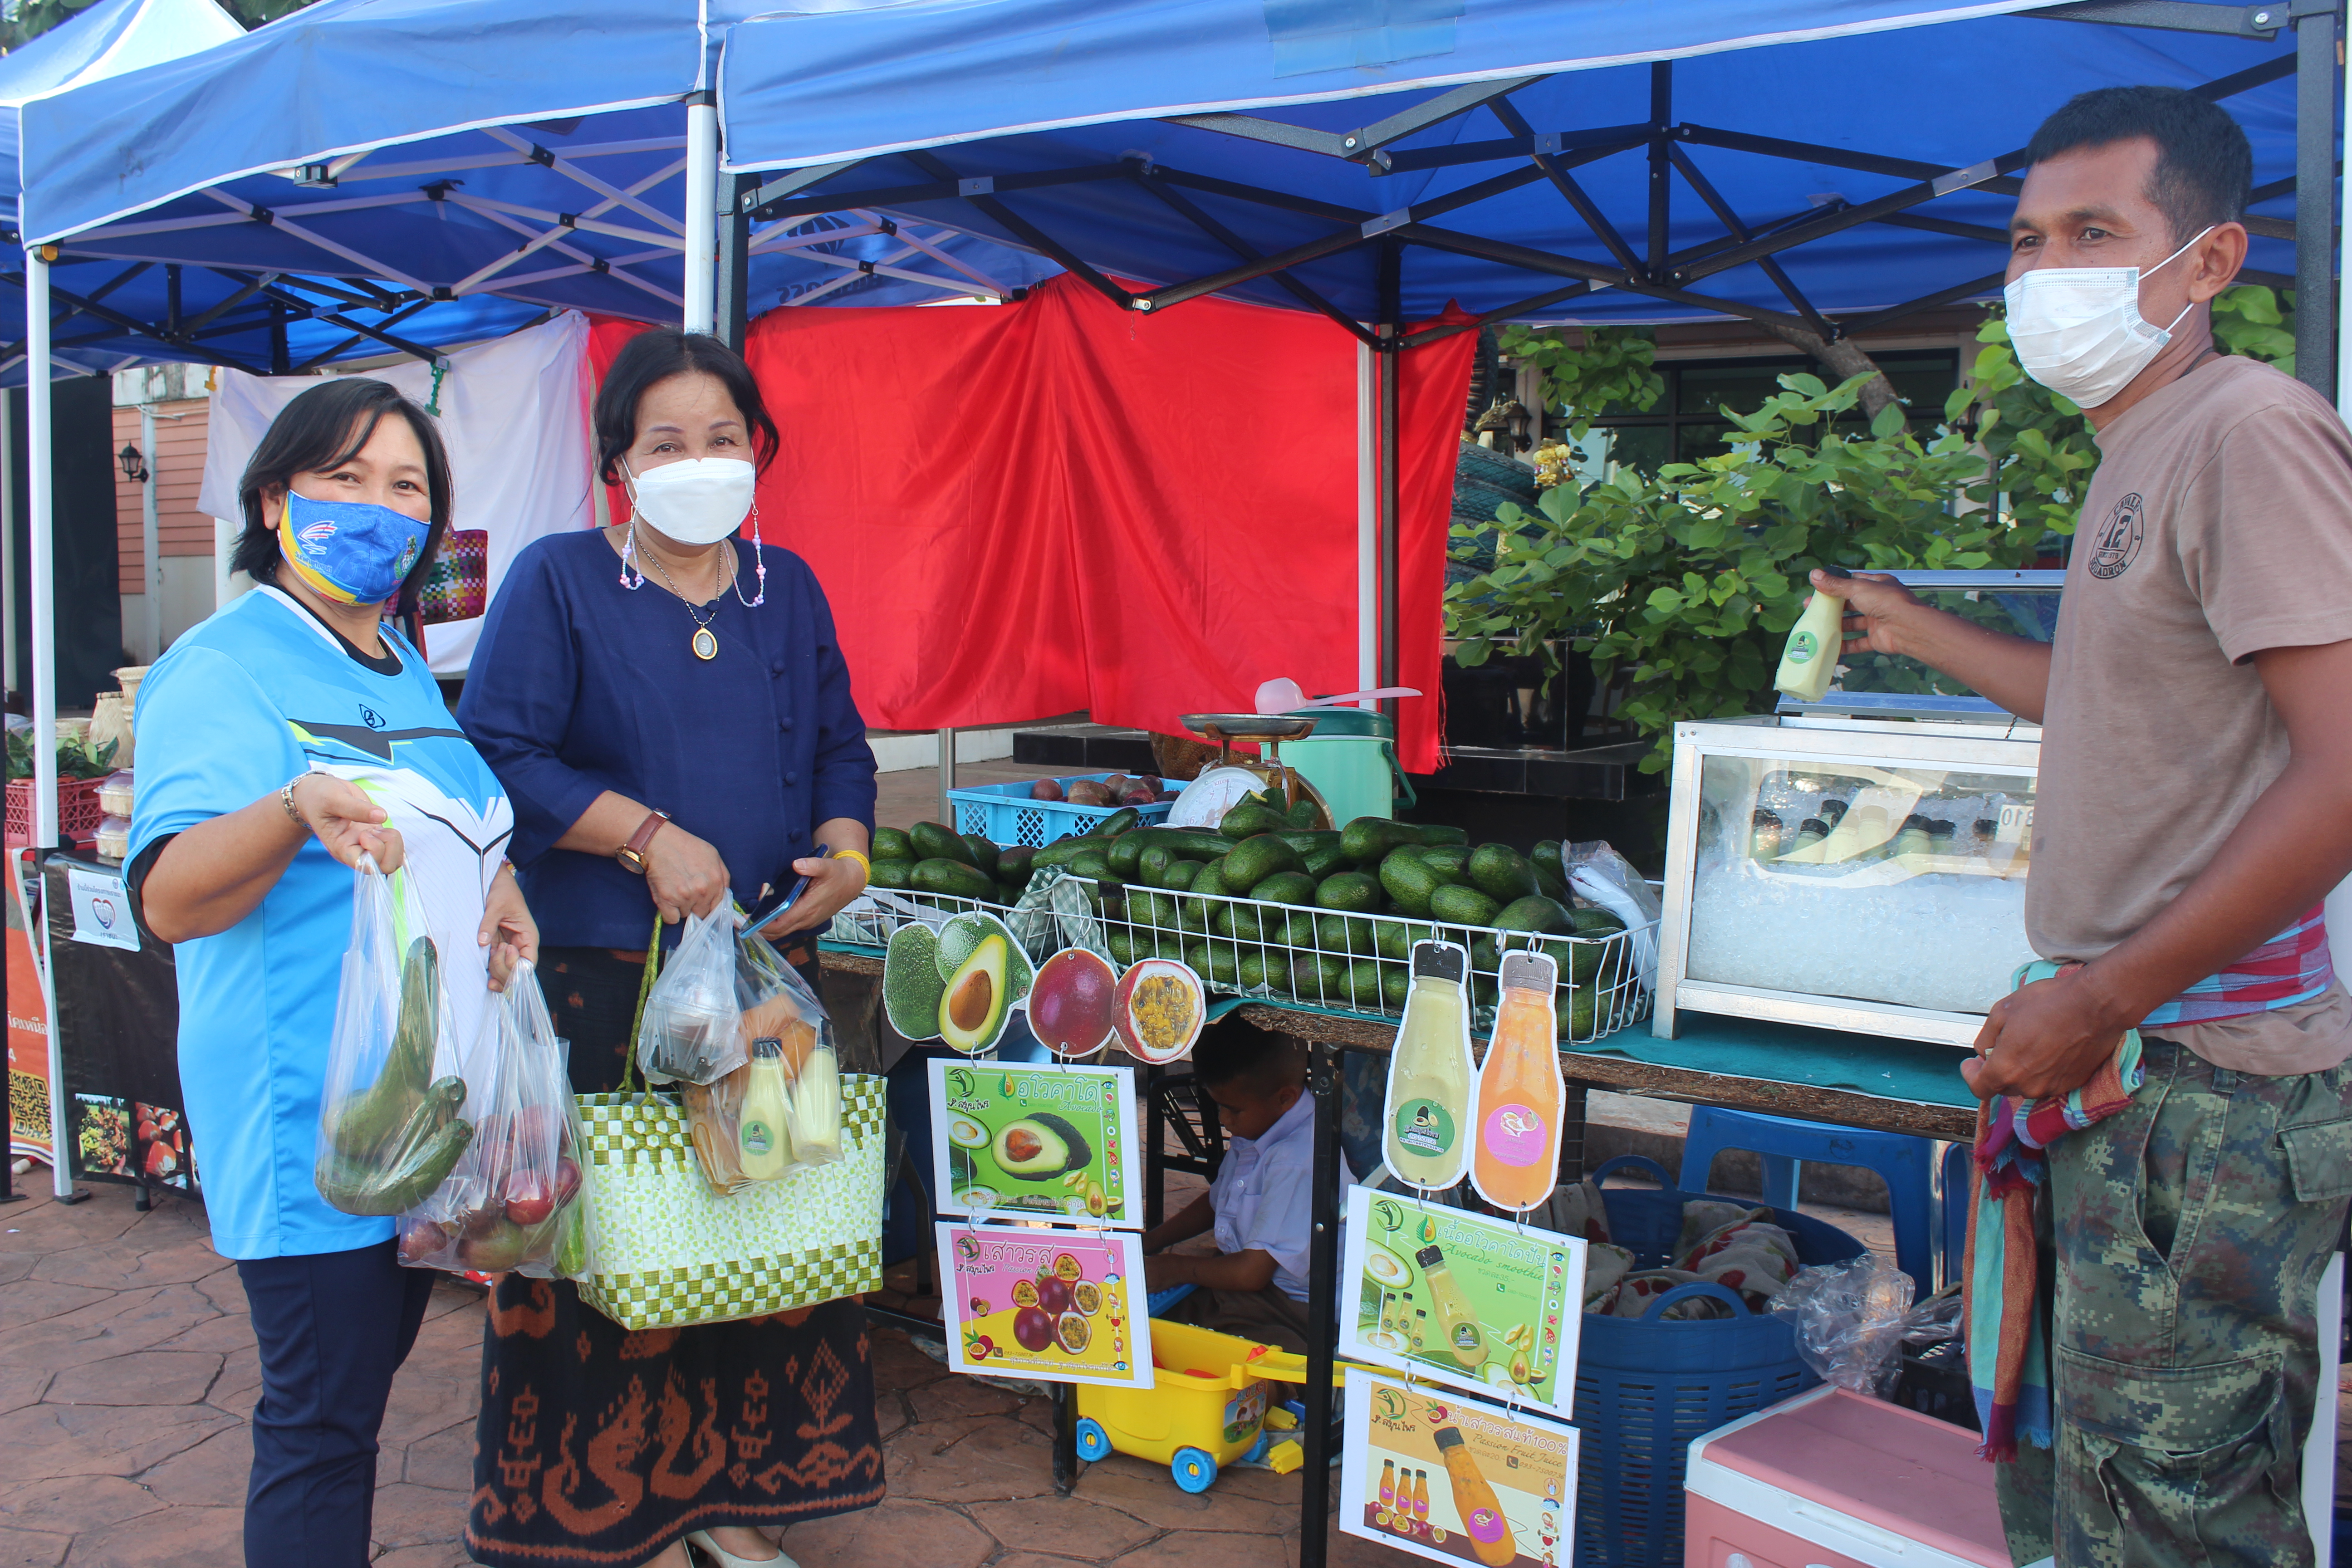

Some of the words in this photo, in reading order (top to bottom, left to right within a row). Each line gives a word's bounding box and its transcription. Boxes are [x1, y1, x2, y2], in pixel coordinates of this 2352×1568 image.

[2102, 514, 2132, 548] 12
[2090, 557, 2126, 577] SQUADRON
[1018, 1073, 1098, 1102] อโวคาโด
[1058, 1100, 1104, 1113] Avocado
[983, 1240, 1055, 1264] เสาวรส
[1437, 1219, 1547, 1268] เนื้ออโวคาโดปั่น
[1002, 1263, 1033, 1274] Passion
[1440, 1242, 1493, 1264] Avocado
[1495, 1261, 1545, 1281] smoothie
[1472, 1433, 1509, 1451] Passion
[1510, 1445, 1535, 1460] Fruit
[1533, 1452, 1563, 1468] Juice
[1519, 1461, 1566, 1480] 093-7500736
